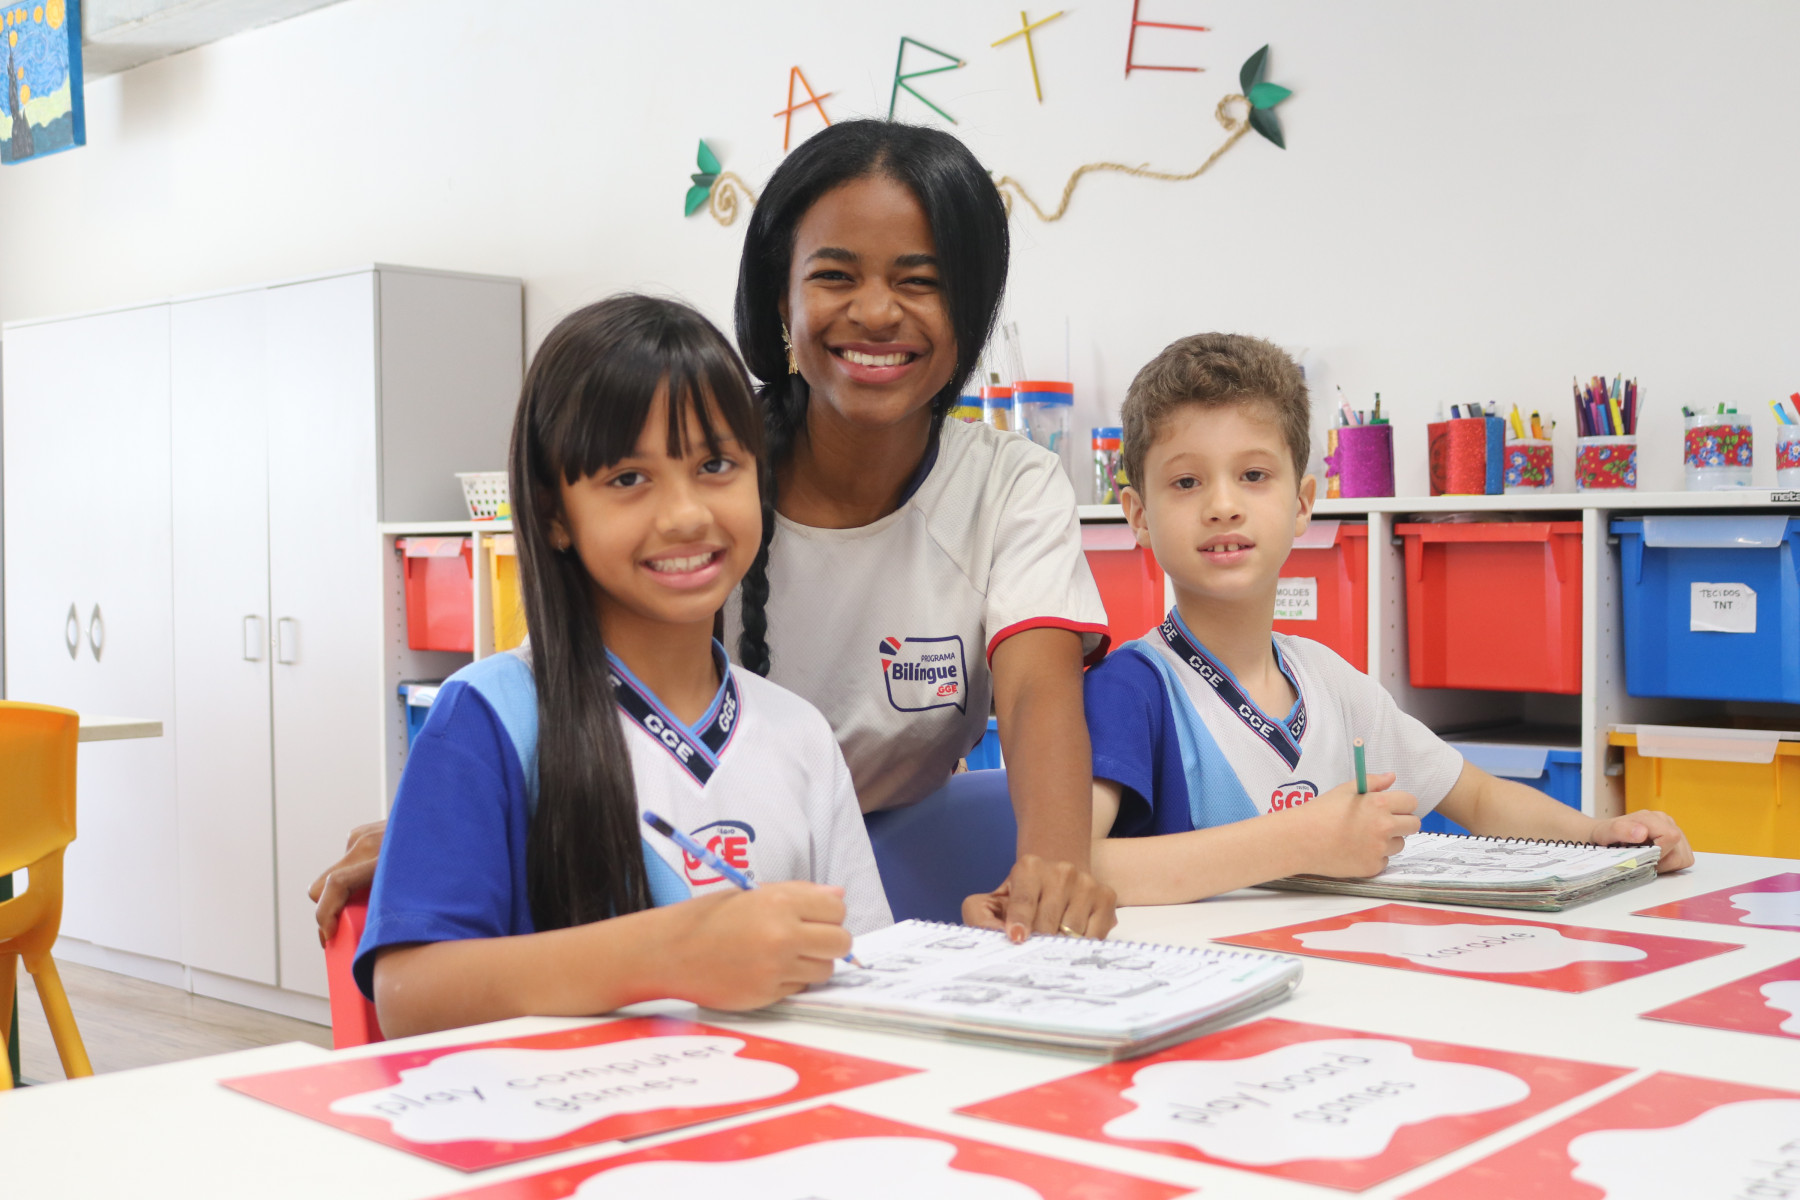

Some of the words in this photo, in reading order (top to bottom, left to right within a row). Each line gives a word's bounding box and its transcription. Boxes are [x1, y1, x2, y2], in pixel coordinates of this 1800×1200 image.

[1276, 598, 1287, 607] DE
[1277, 588, 1310, 597] MOLDES
[1699, 588, 1741, 598] TECIDOS
[1713, 601, 1734, 610] TNT
[920, 652, 956, 662] PROGRAMA
[1188, 655, 1224, 688] GGE
[892, 662, 957, 685] Bilíngue
[938, 685, 957, 694] GGE
[719, 691, 736, 732] GGE
[1238, 704, 1275, 738] GGE
[1290, 706, 1306, 737] GG
[643, 713, 694, 763] GGE
[1401, 932, 1536, 959] karaoke
[373, 1084, 486, 1117] play
[506, 1044, 725, 1090] computer
[534, 1076, 699, 1114] games
[1168, 1090, 1272, 1128] play
[1234, 1051, 1372, 1093] board
[1292, 1080, 1417, 1125] games
